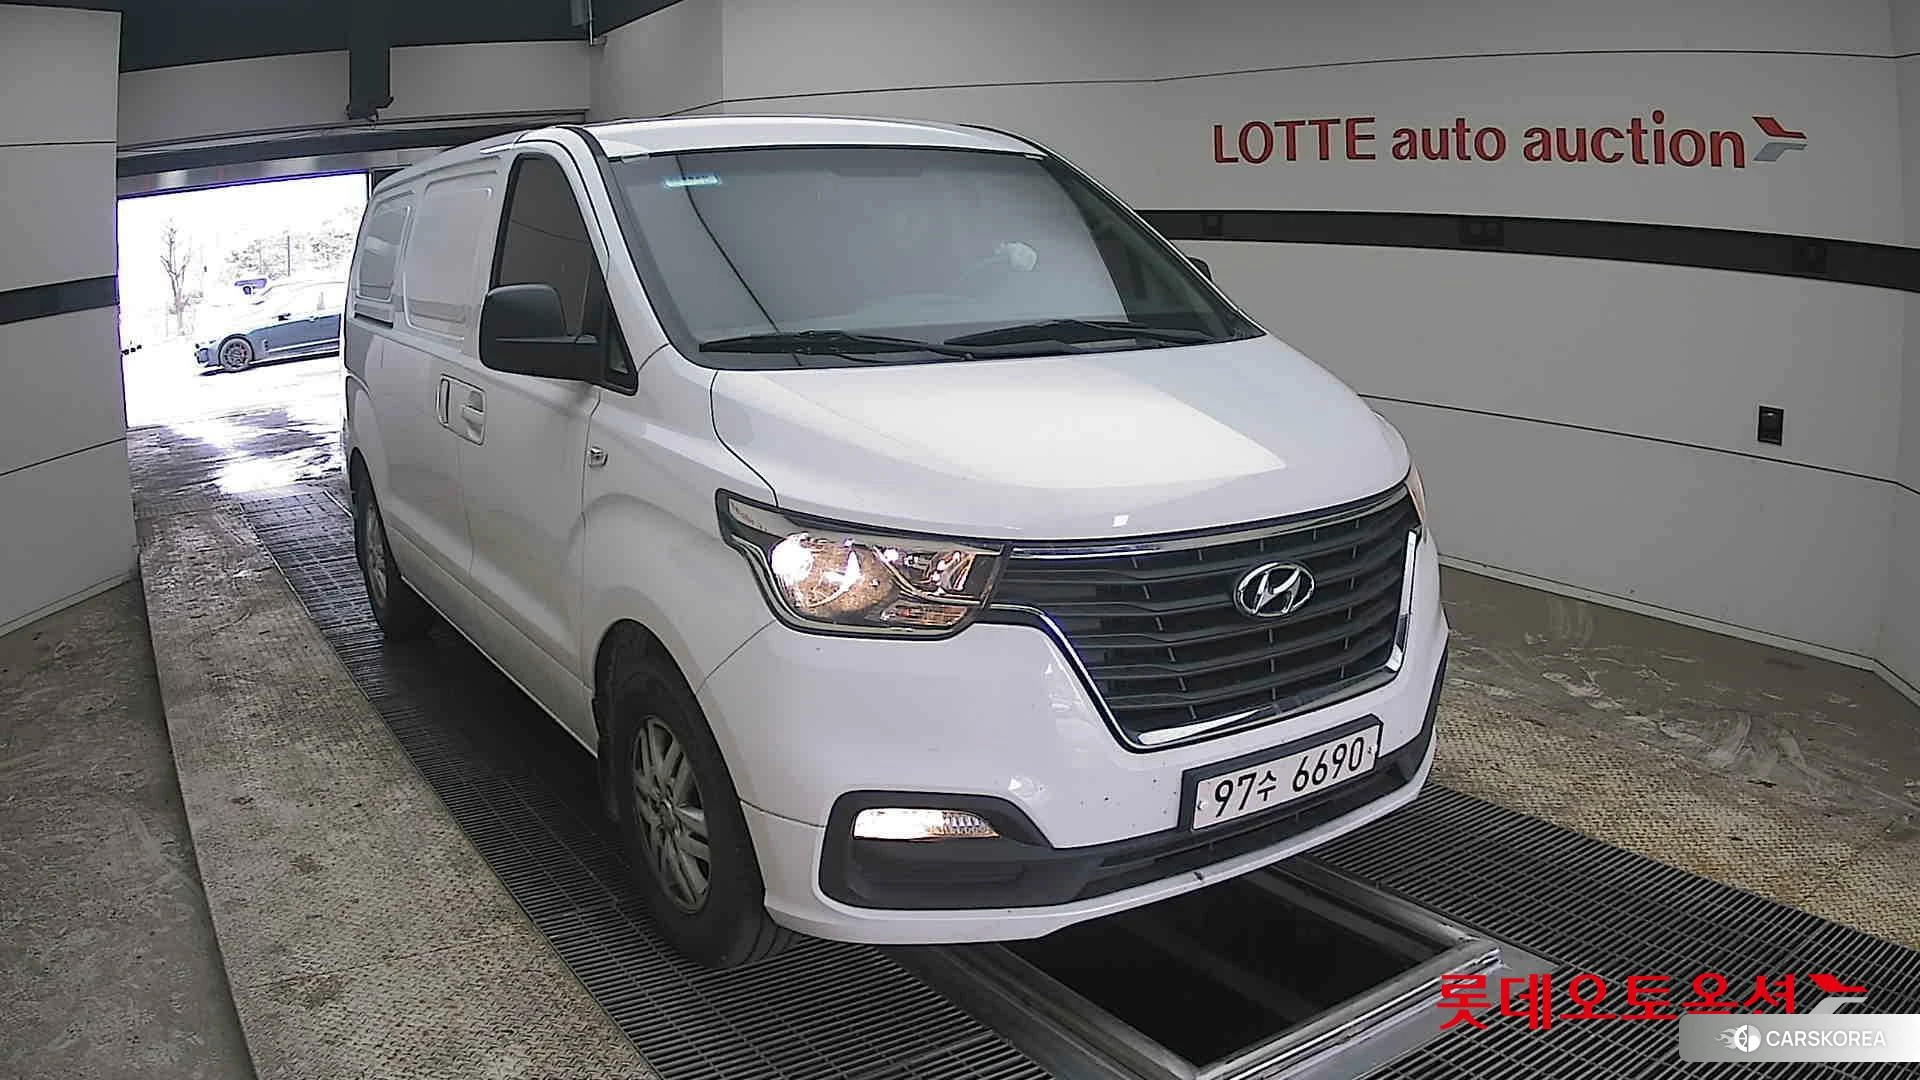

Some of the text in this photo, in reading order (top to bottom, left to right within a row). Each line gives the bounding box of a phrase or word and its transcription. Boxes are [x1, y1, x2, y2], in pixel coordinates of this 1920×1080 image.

[1213, 110, 1746, 169] LOTTE auto auction
[1214, 736, 1365, 818] 97수 6690
